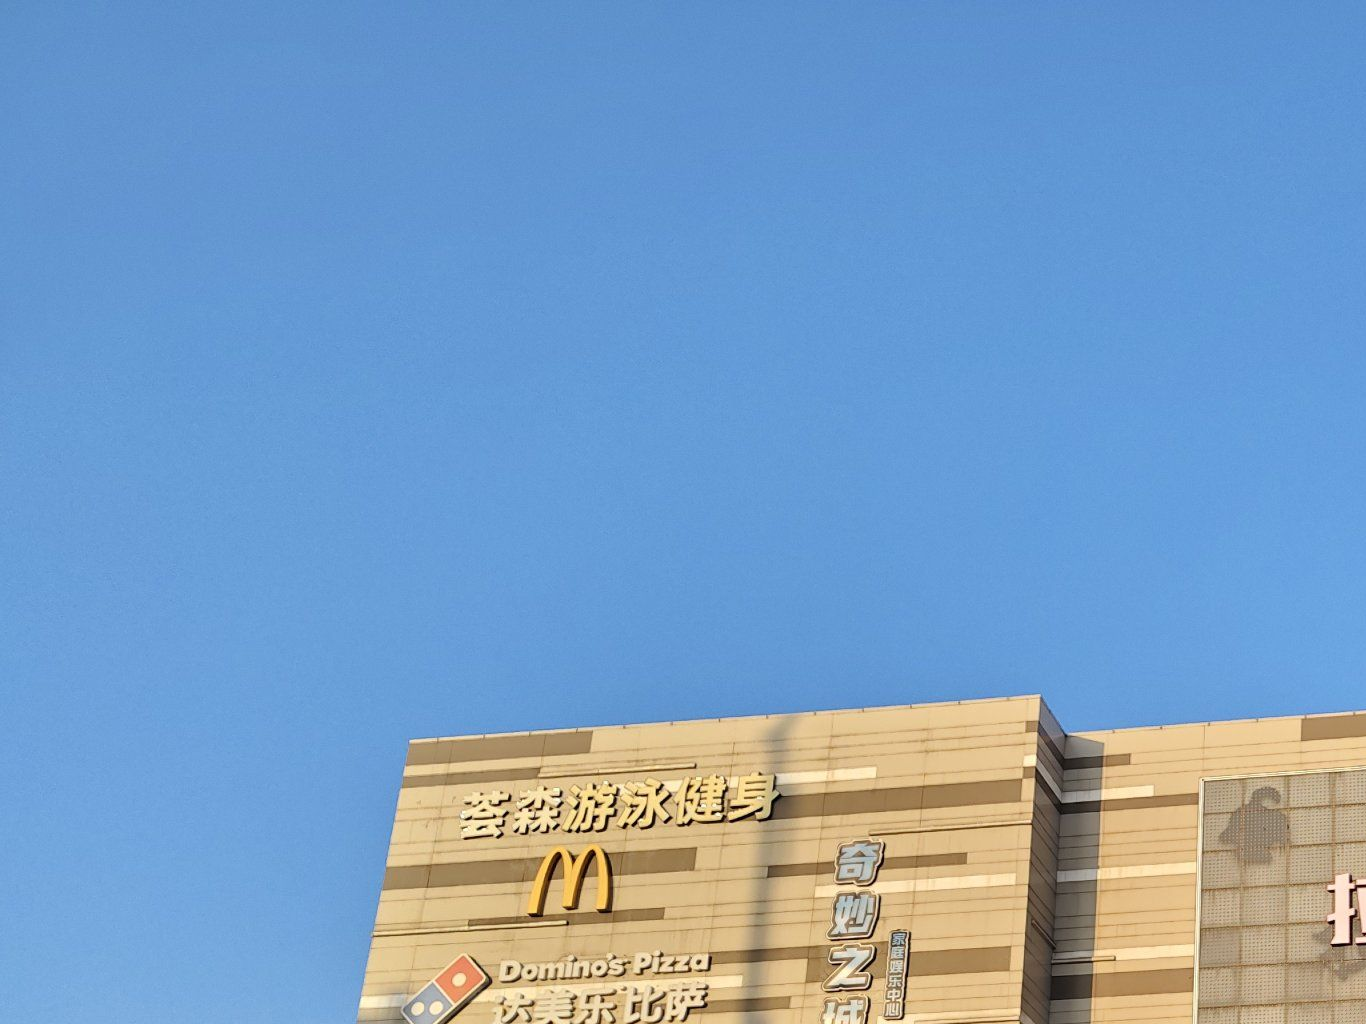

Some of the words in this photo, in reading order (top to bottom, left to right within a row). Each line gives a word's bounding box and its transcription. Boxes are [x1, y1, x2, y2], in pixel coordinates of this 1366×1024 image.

[499, 952, 625, 983] Domino's
[632, 949, 711, 975] Pizza
[883, 929, 911, 1020] 家庭娱乐中心
